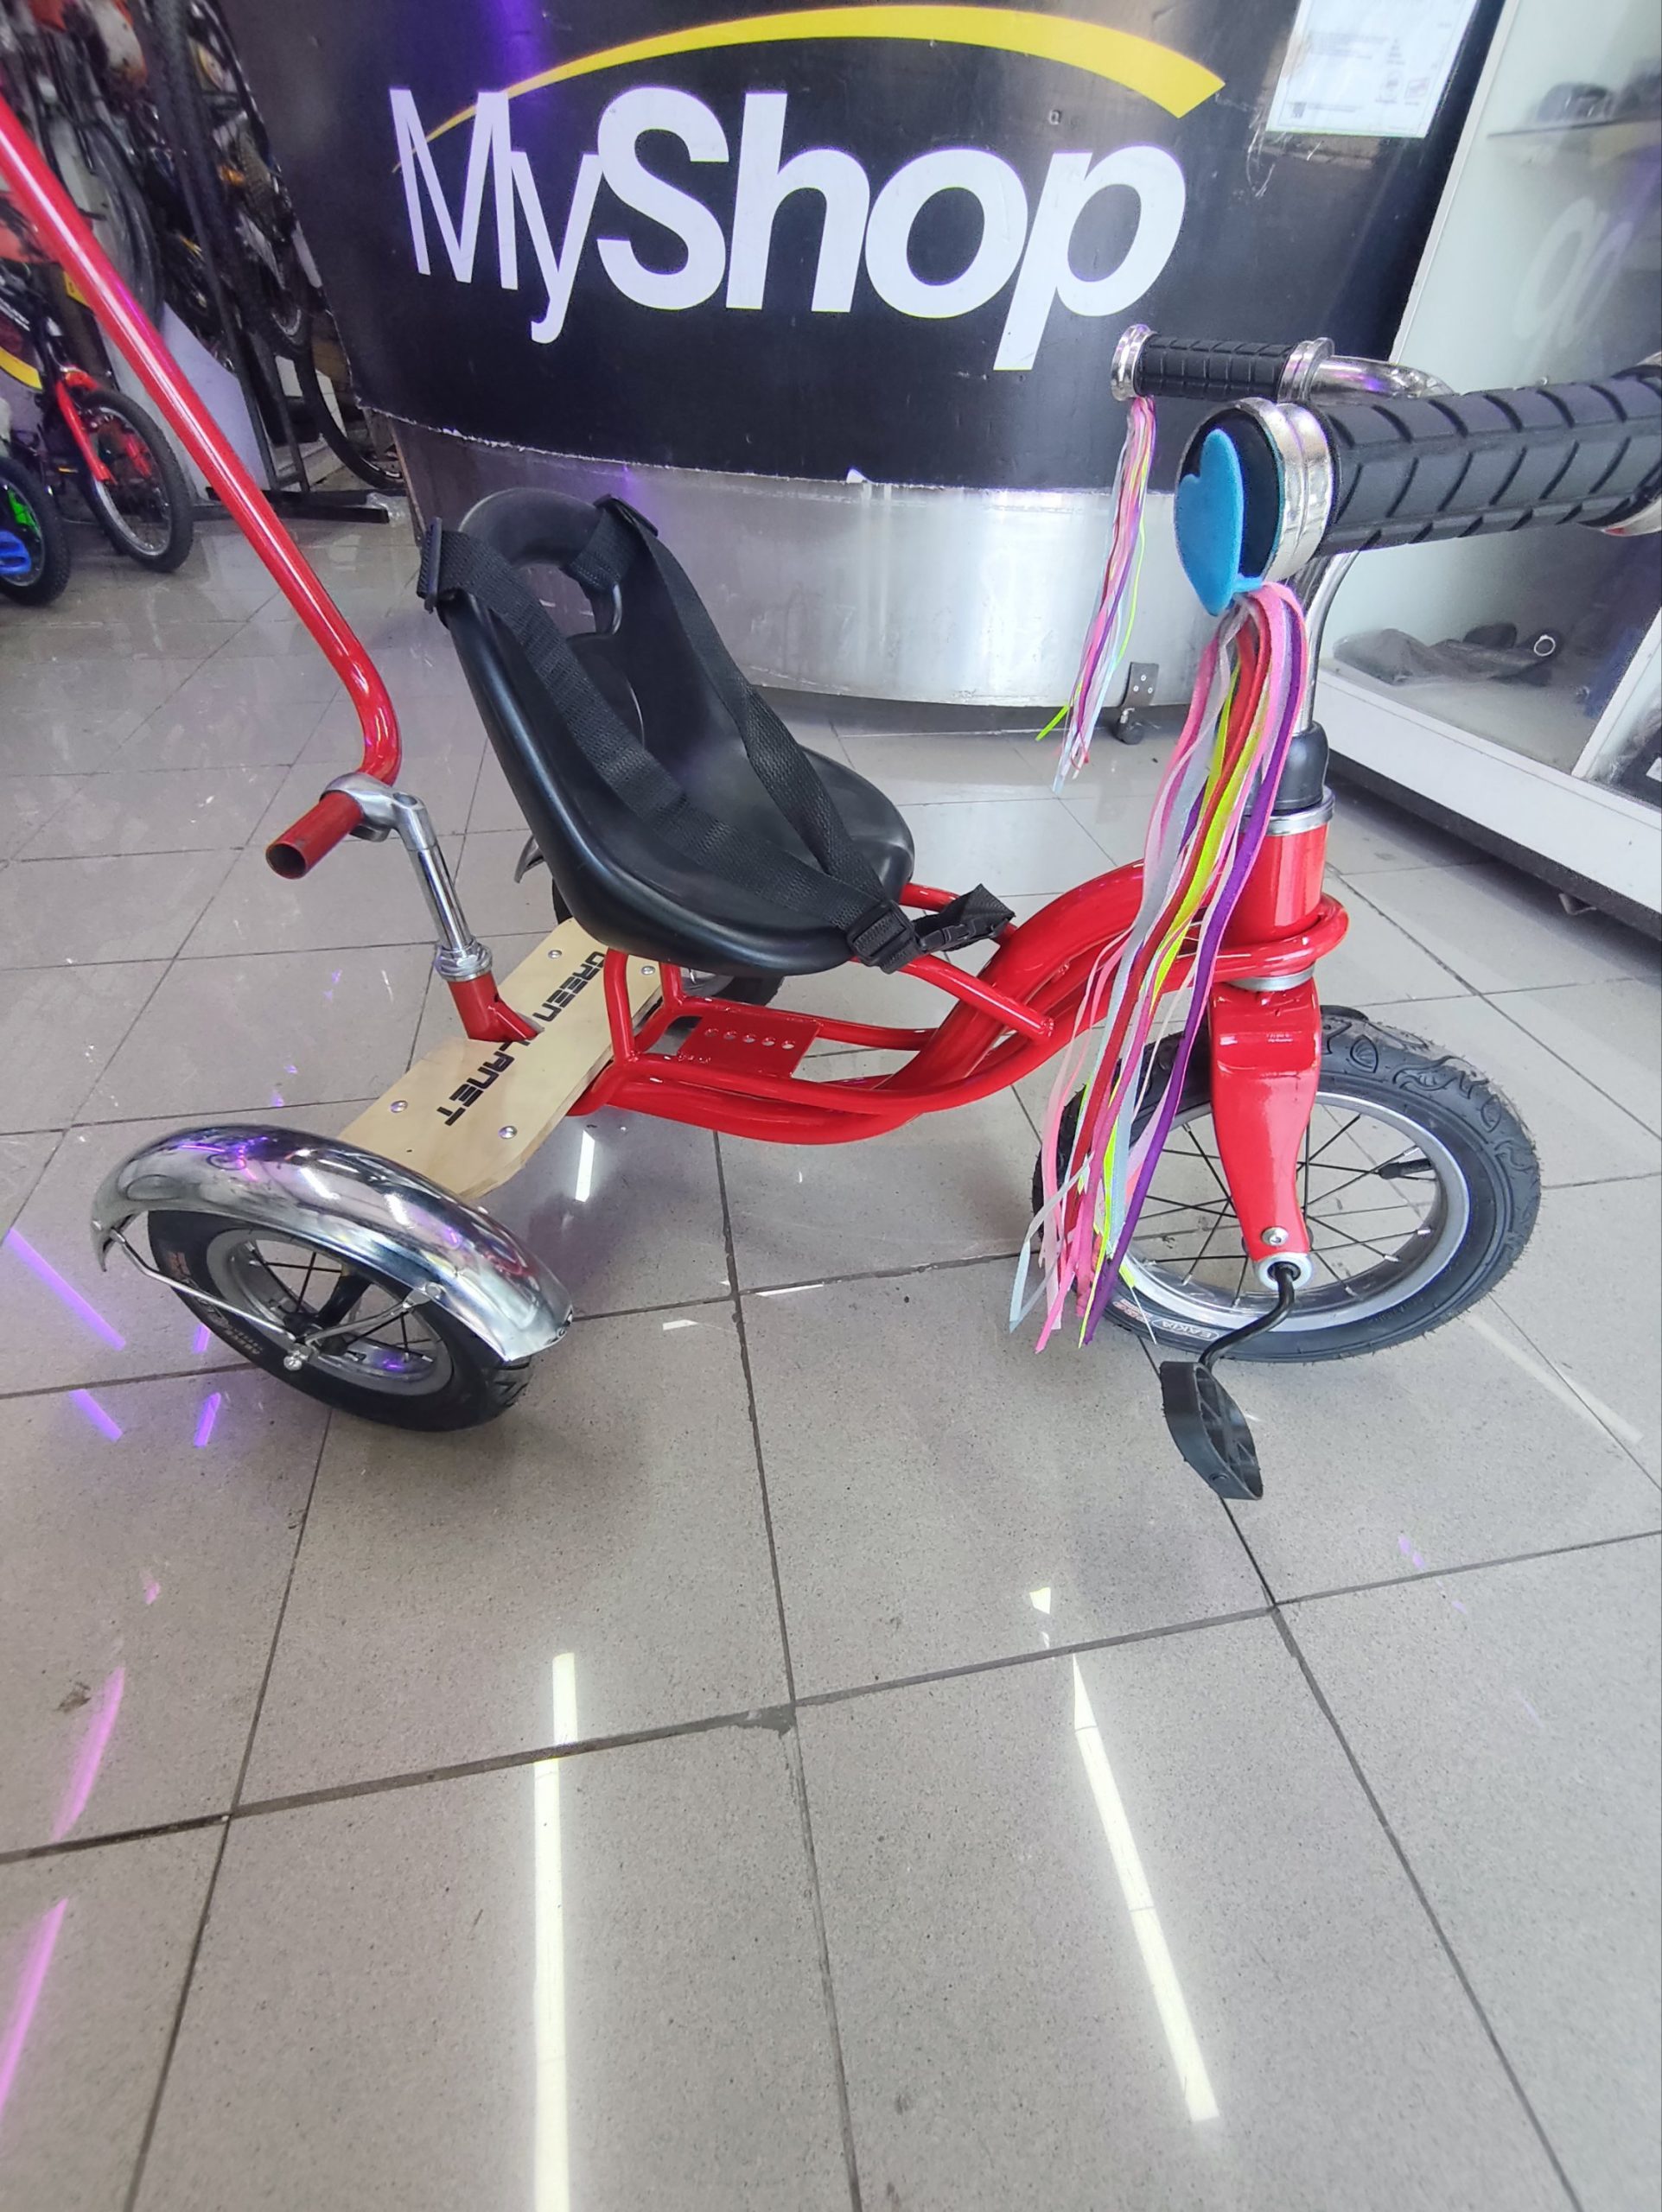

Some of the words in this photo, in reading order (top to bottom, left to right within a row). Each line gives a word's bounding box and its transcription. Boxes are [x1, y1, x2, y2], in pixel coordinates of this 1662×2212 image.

[389, 86, 1187, 371] MyShop
[532, 951, 606, 1022] GREEN
[436, 1039, 532, 1127] LANET
